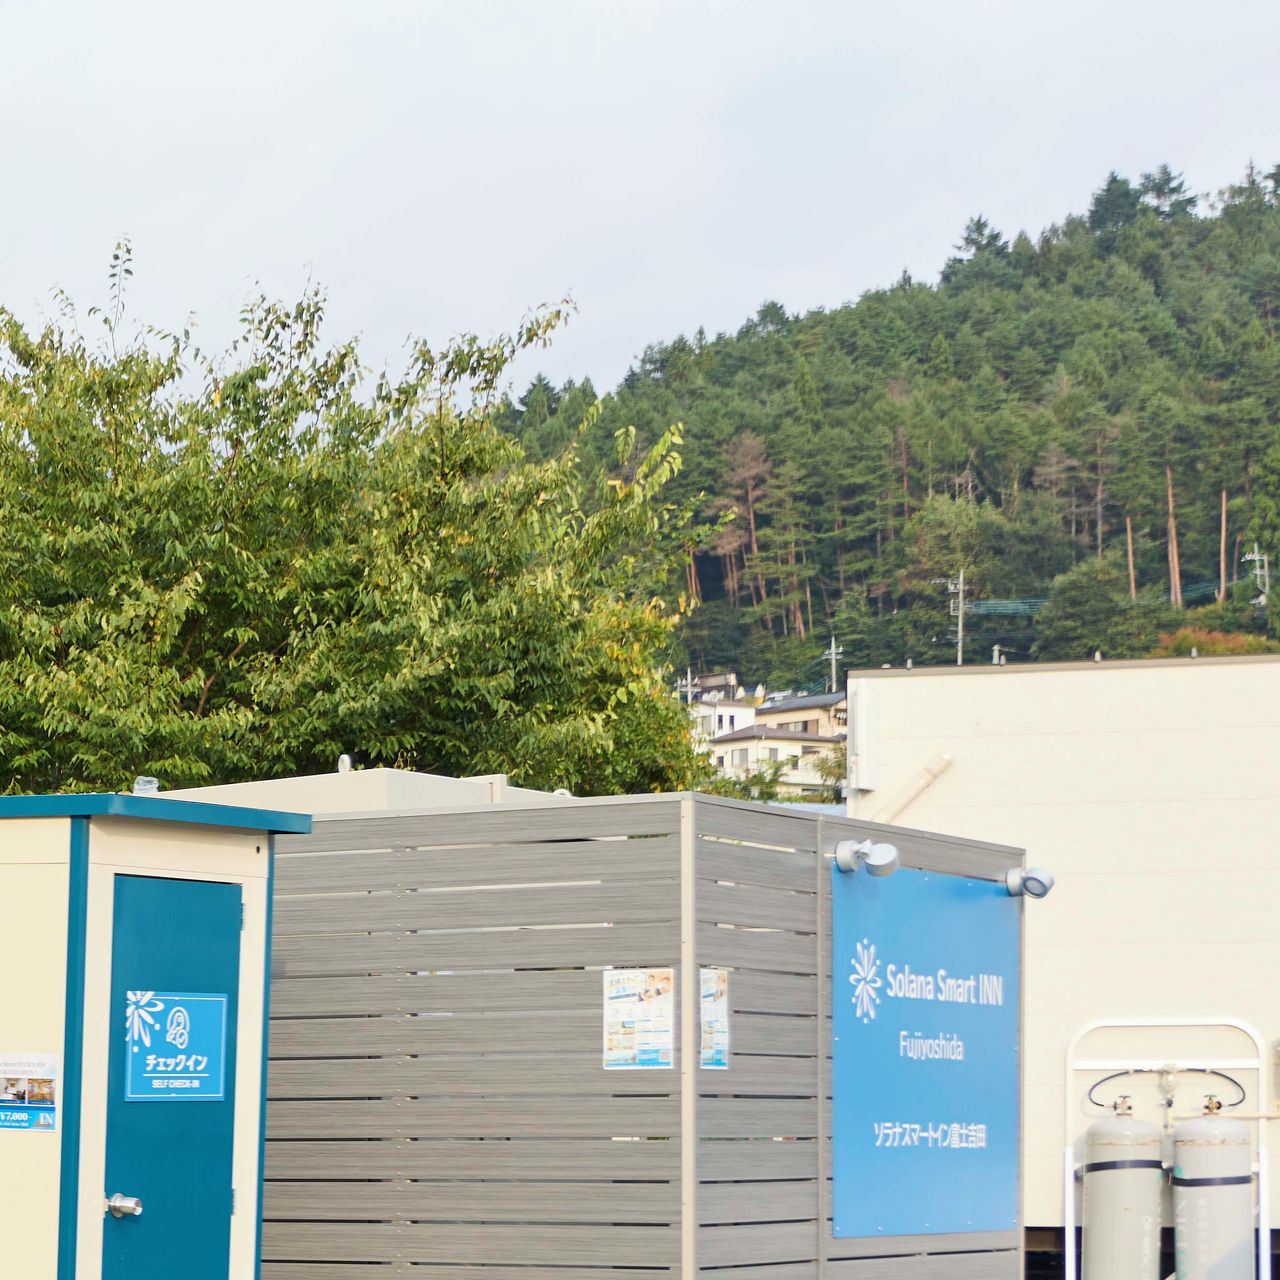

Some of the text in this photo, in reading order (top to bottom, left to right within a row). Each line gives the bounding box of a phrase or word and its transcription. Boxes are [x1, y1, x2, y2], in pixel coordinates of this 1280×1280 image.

[886, 963, 1003, 1006] Solana Smart INN
[900, 1030, 964, 1060] Fujiyoshida
[145, 1054, 208, 1071] チェックイン
[151, 1079, 168, 1088] SELF
[873, 1121, 987, 1149] ソラナスマートイン富士吉田
